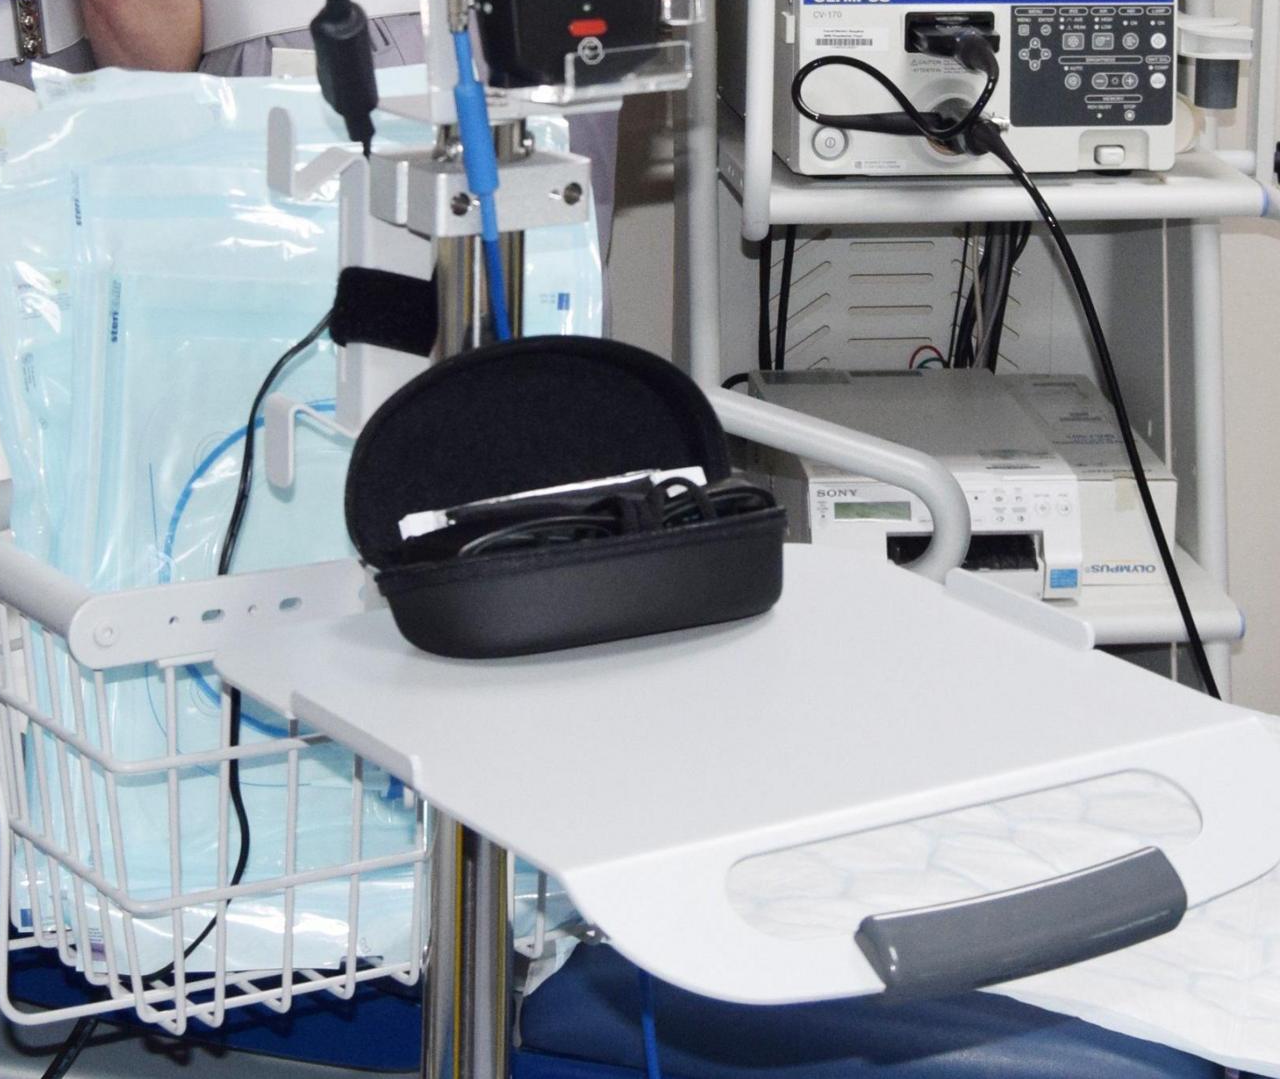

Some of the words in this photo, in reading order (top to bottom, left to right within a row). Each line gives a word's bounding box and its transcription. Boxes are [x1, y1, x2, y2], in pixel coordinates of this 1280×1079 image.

[813, 10, 842, 18] CV-170
[817, 489, 858, 498] SONY
[1091, 564, 1156, 574] OLYMPUS
